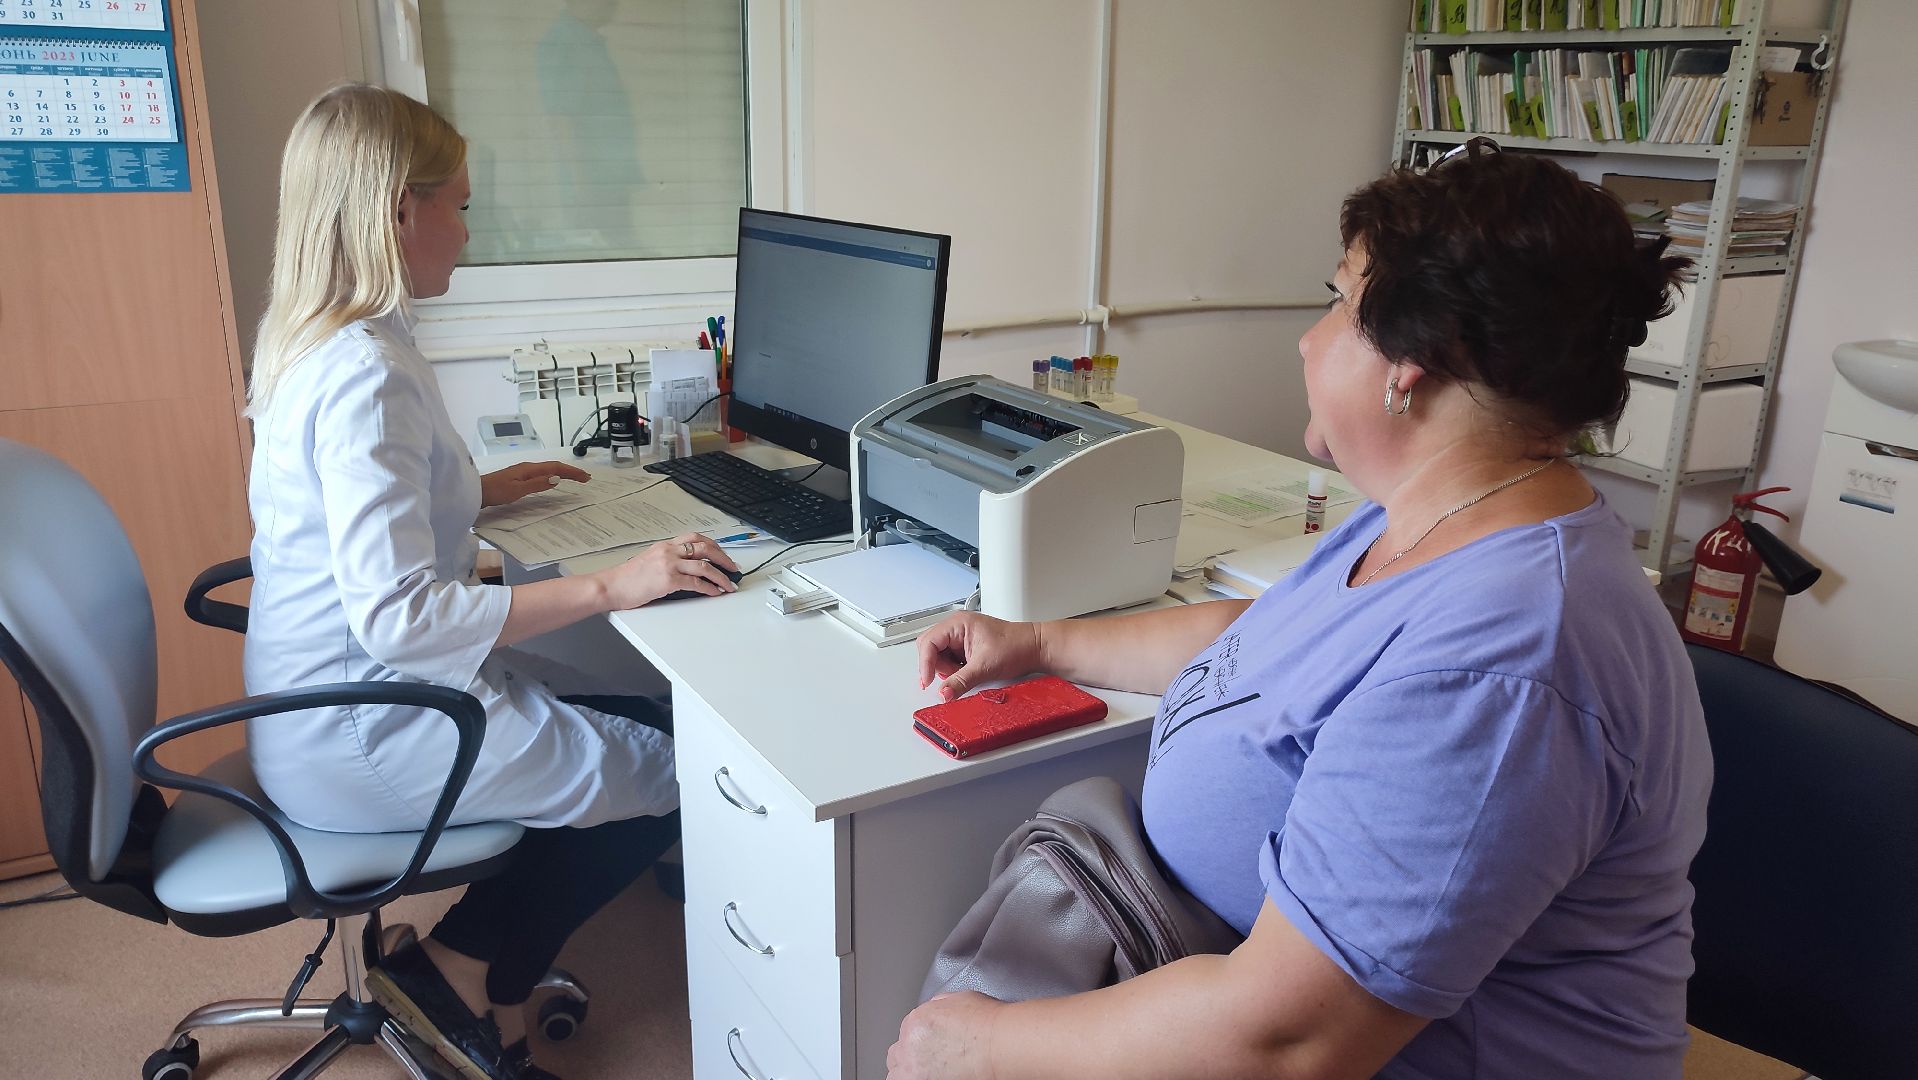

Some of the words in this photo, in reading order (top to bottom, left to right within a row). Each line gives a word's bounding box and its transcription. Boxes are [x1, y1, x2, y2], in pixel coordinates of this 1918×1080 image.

[79, 1, 91, 9] 25
[107, 2, 119, 11] 26
[135, 3, 147, 12] 27
[23, 11, 36, 20] 30
[52, 12, 64, 21] 31
[42, 51, 75, 61] 2023
[81, 52, 120, 62] JUNE
[120, 92, 131, 100] 10
[7, 103, 20, 111] 13
[36, 103, 49, 111] 14
[93, 104, 106, 112] 16
[148, 105, 160, 113] 18
[9, 115, 22, 123] 20
[67, 116, 80, 124] 22
[95, 116, 107, 124] 23
[149, 117, 161, 125] 25
[11, 128, 24, 136] 27
[40, 128, 53, 136] 28
[69, 128, 81, 136] 29
